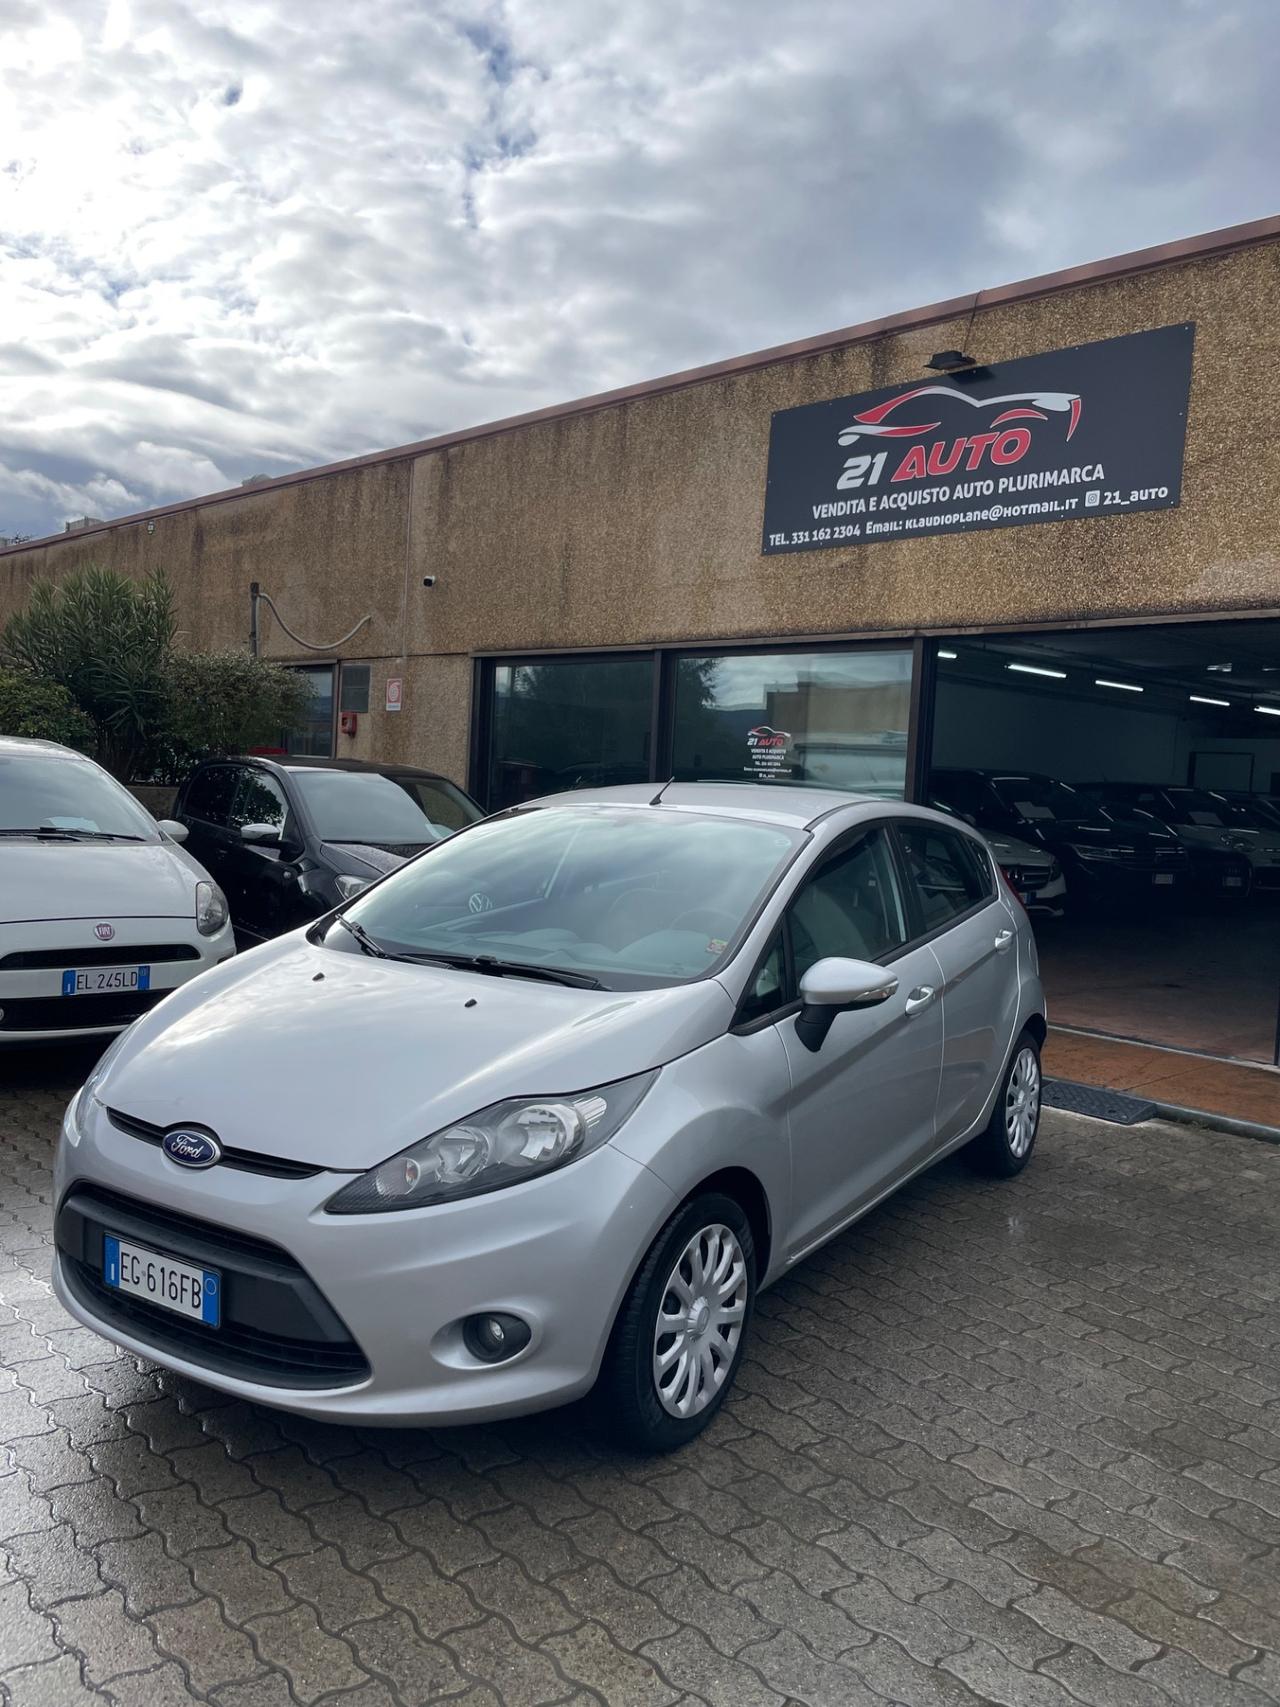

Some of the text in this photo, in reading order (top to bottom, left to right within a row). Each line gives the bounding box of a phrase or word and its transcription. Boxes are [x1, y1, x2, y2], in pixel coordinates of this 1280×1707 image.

[836, 428, 1032, 490] 21 AUTO
[812, 463, 1105, 520] VENDITA E ACQUISTO AUTO PLURIMARCA
[769, 532, 790, 547] TEL.
[791, 530, 810, 545] 331
[812, 527, 831, 542] 162
[833, 523, 861, 539] 2304
[747, 737, 785, 746] 21 AUTO
[76, 974, 92, 990] EL
[97, 971, 138, 989] 245LD
[170, 1134, 205, 1159] Ford
[120, 1251, 141, 1285] EG
[147, 1262, 202, 1309] 616FB
